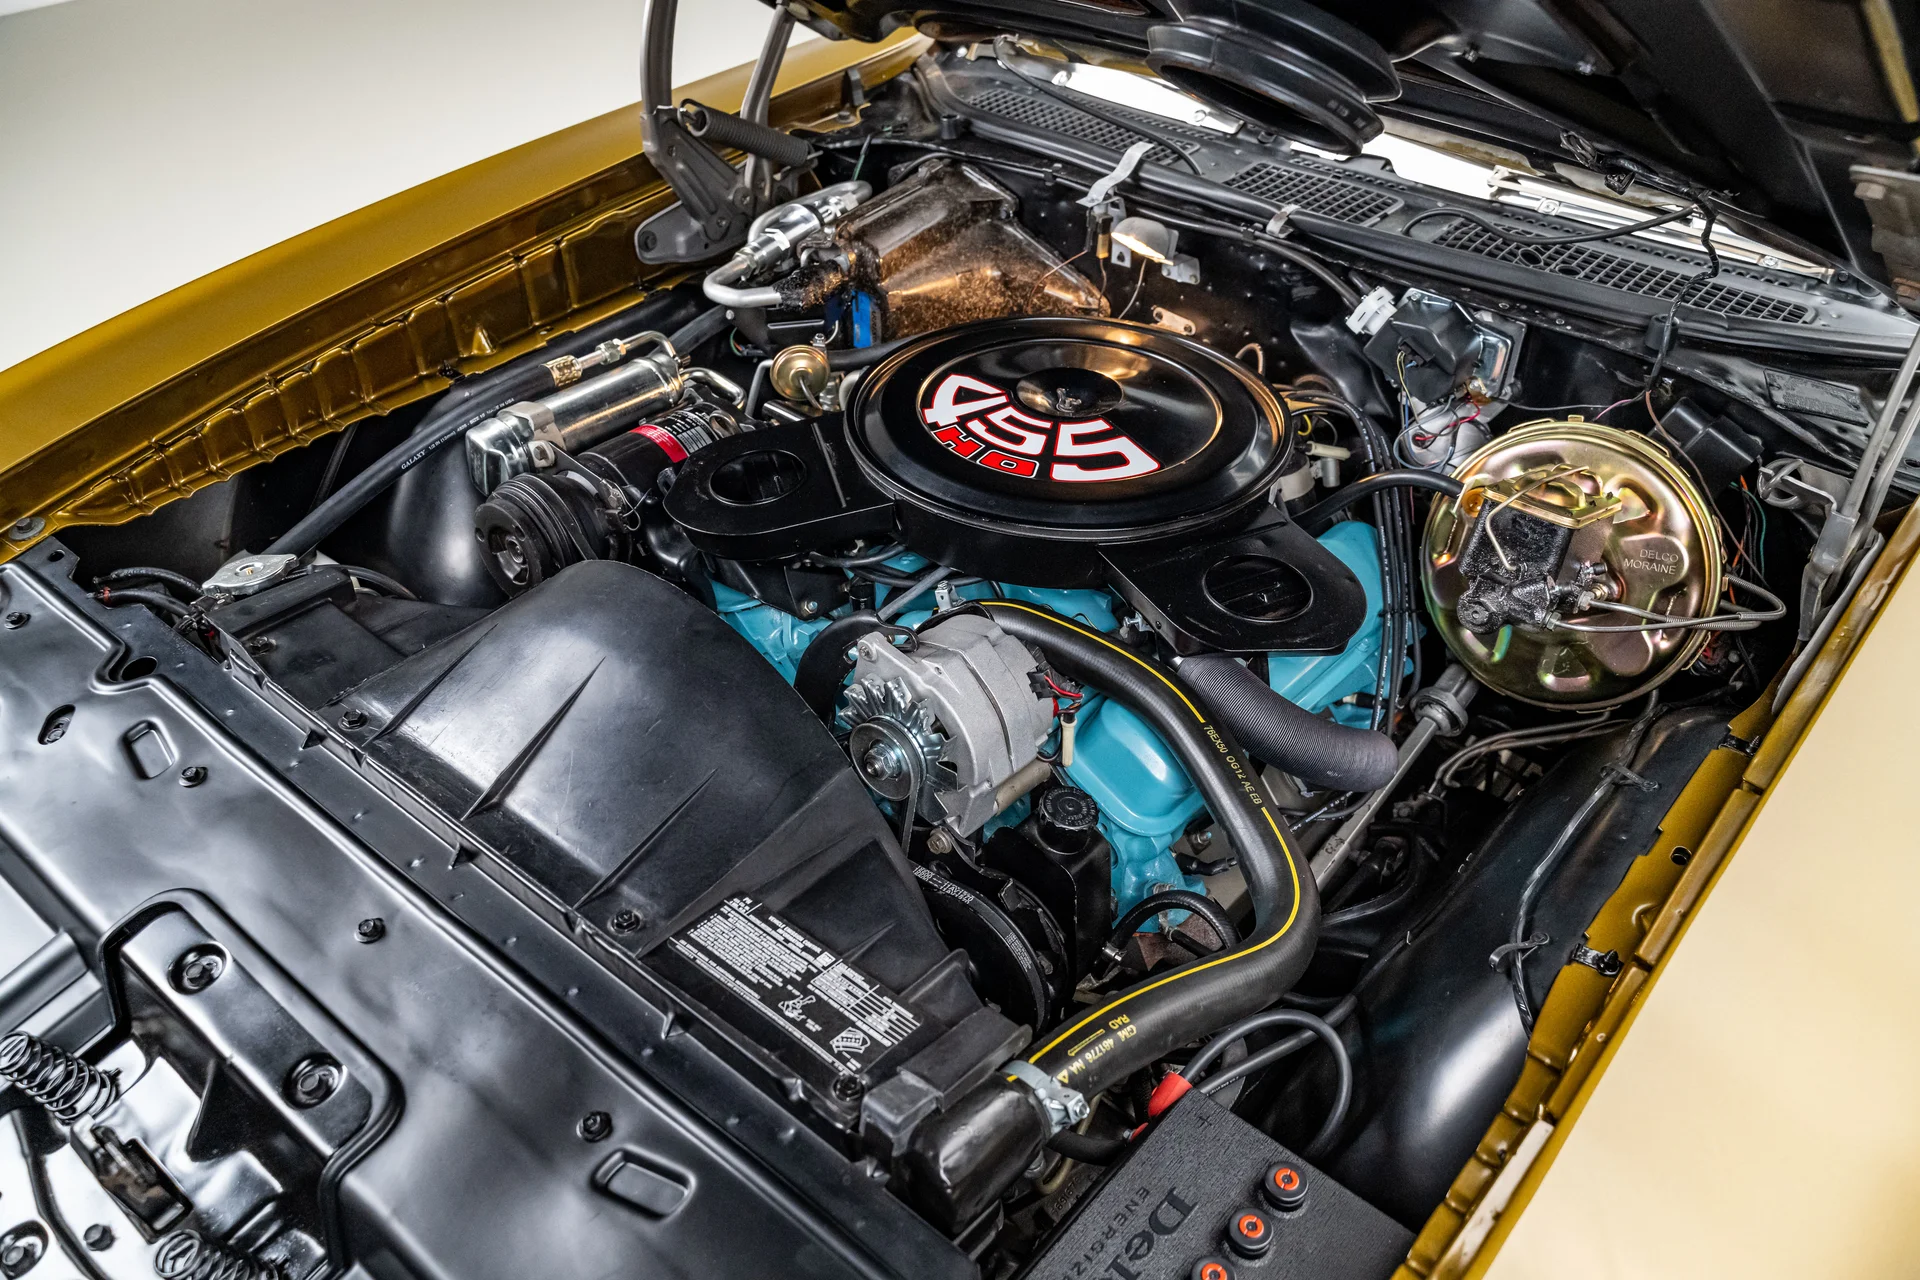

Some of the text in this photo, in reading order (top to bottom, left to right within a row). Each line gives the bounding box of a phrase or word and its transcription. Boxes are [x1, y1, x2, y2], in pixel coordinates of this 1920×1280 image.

[924, 373, 1161, 482] 455
[401, 450, 426, 470] GALAXY
[932, 424, 1040, 478] HO
[1639, 548, 1679, 562] DELCO
[1623, 558, 1676, 574] MORAINE
[1204, 725, 1228, 753] 76EX50
[1242, 780, 1254, 793] AE
[1249, 791, 1262, 806] EB
[1108, 1014, 1130, 1029] RAD
[1116, 1025, 1137, 1041] GM
[1068, 1059, 1085, 1075] NA
[1104, 1187, 1197, 1280] Del
